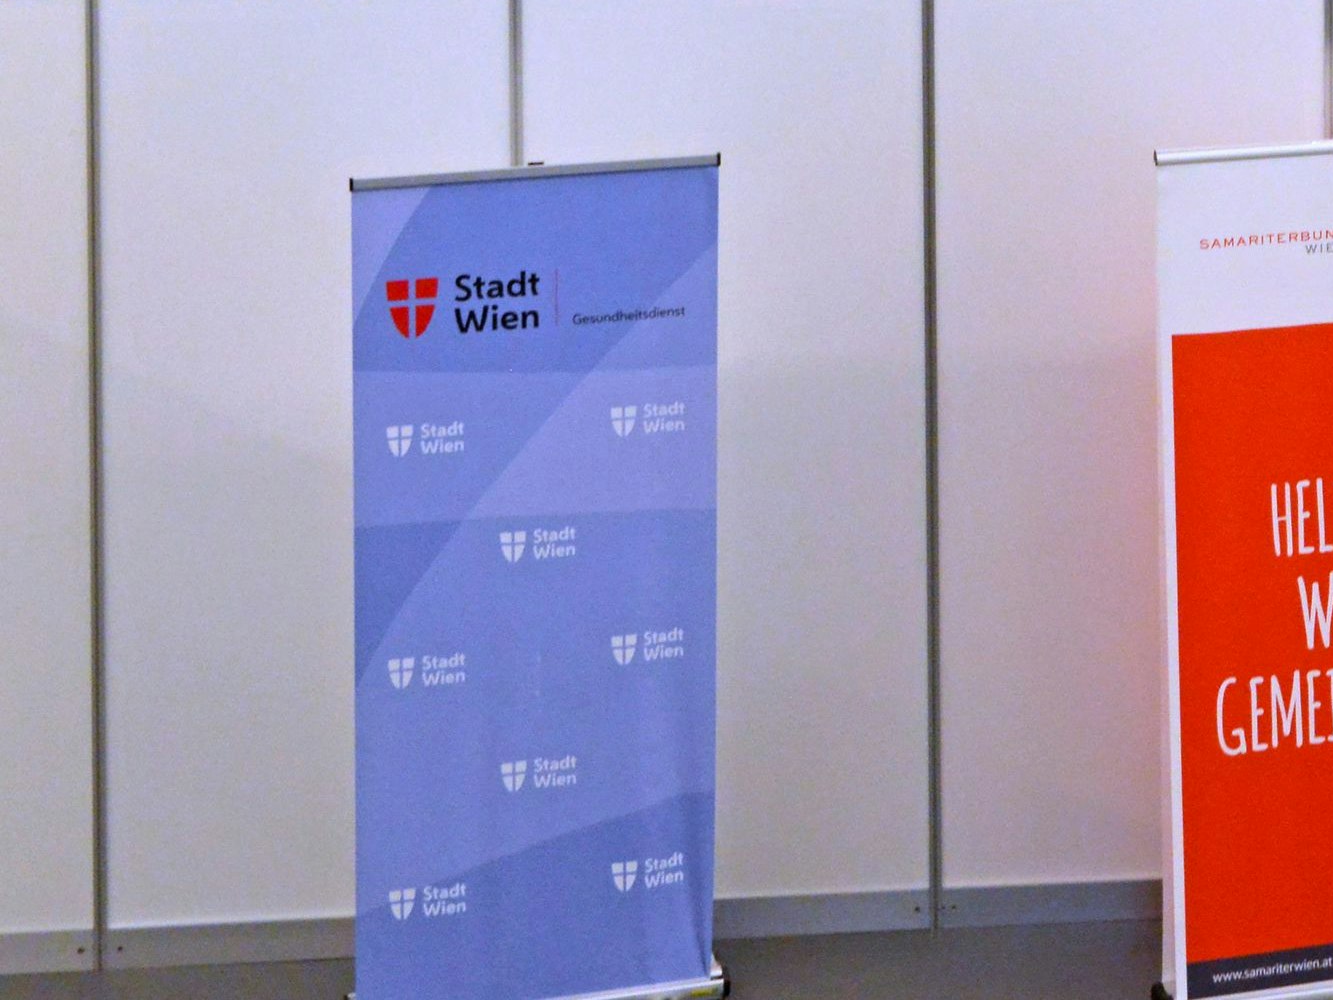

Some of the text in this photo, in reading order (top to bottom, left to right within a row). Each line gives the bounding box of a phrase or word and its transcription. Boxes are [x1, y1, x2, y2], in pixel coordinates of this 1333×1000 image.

[455, 271, 540, 301] Stadt
[454, 305, 540, 334] Wien
[572, 306, 686, 326] Gesundheitsdienst
[643, 402, 685, 417] Stadt
[420, 421, 465, 438] Stadt
[643, 418, 685, 433] Wien
[420, 438, 465, 455] Wien
[533, 527, 577, 544] Stadt
[533, 543, 577, 560] Wien
[643, 627, 684, 644] Stadt
[643, 643, 684, 661] Wien
[421, 653, 466, 671] Stadt
[421, 669, 466, 687] Wien
[533, 755, 577, 772] Stadt
[533, 771, 577, 789] Wien
[644, 852, 684, 872] Stadt
[644, 869, 684, 889] Wien
[423, 883, 466, 901] Stadt
[423, 899, 466, 917] Wien
[1212, 955, 1333, 985] www.samariterwien.at
